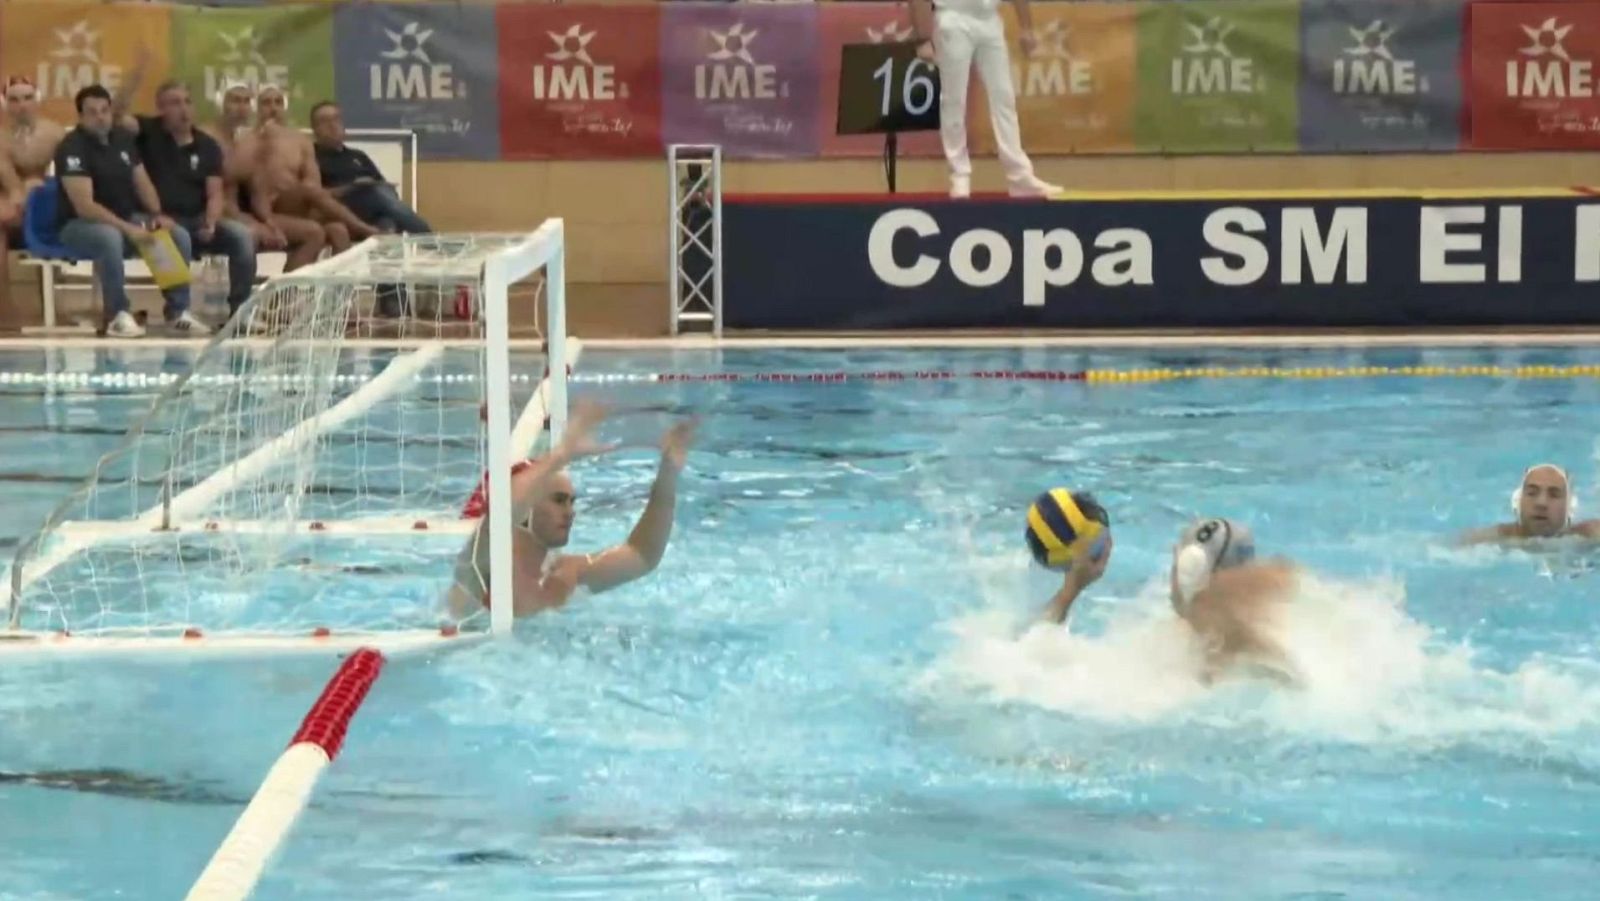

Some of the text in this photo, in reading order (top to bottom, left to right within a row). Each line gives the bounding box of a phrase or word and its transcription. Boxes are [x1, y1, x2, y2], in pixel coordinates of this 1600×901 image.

[370, 64, 453, 99] IME
[533, 64, 615, 99] IME
[695, 64, 776, 99] IME
[873, 57, 935, 116] 16
[1172, 58, 1253, 94] IME
[1333, 59, 1416, 94] IME
[1506, 60, 1593, 97] IME
[868, 208, 1154, 306] Copa
[1200, 206, 1368, 286] SM
